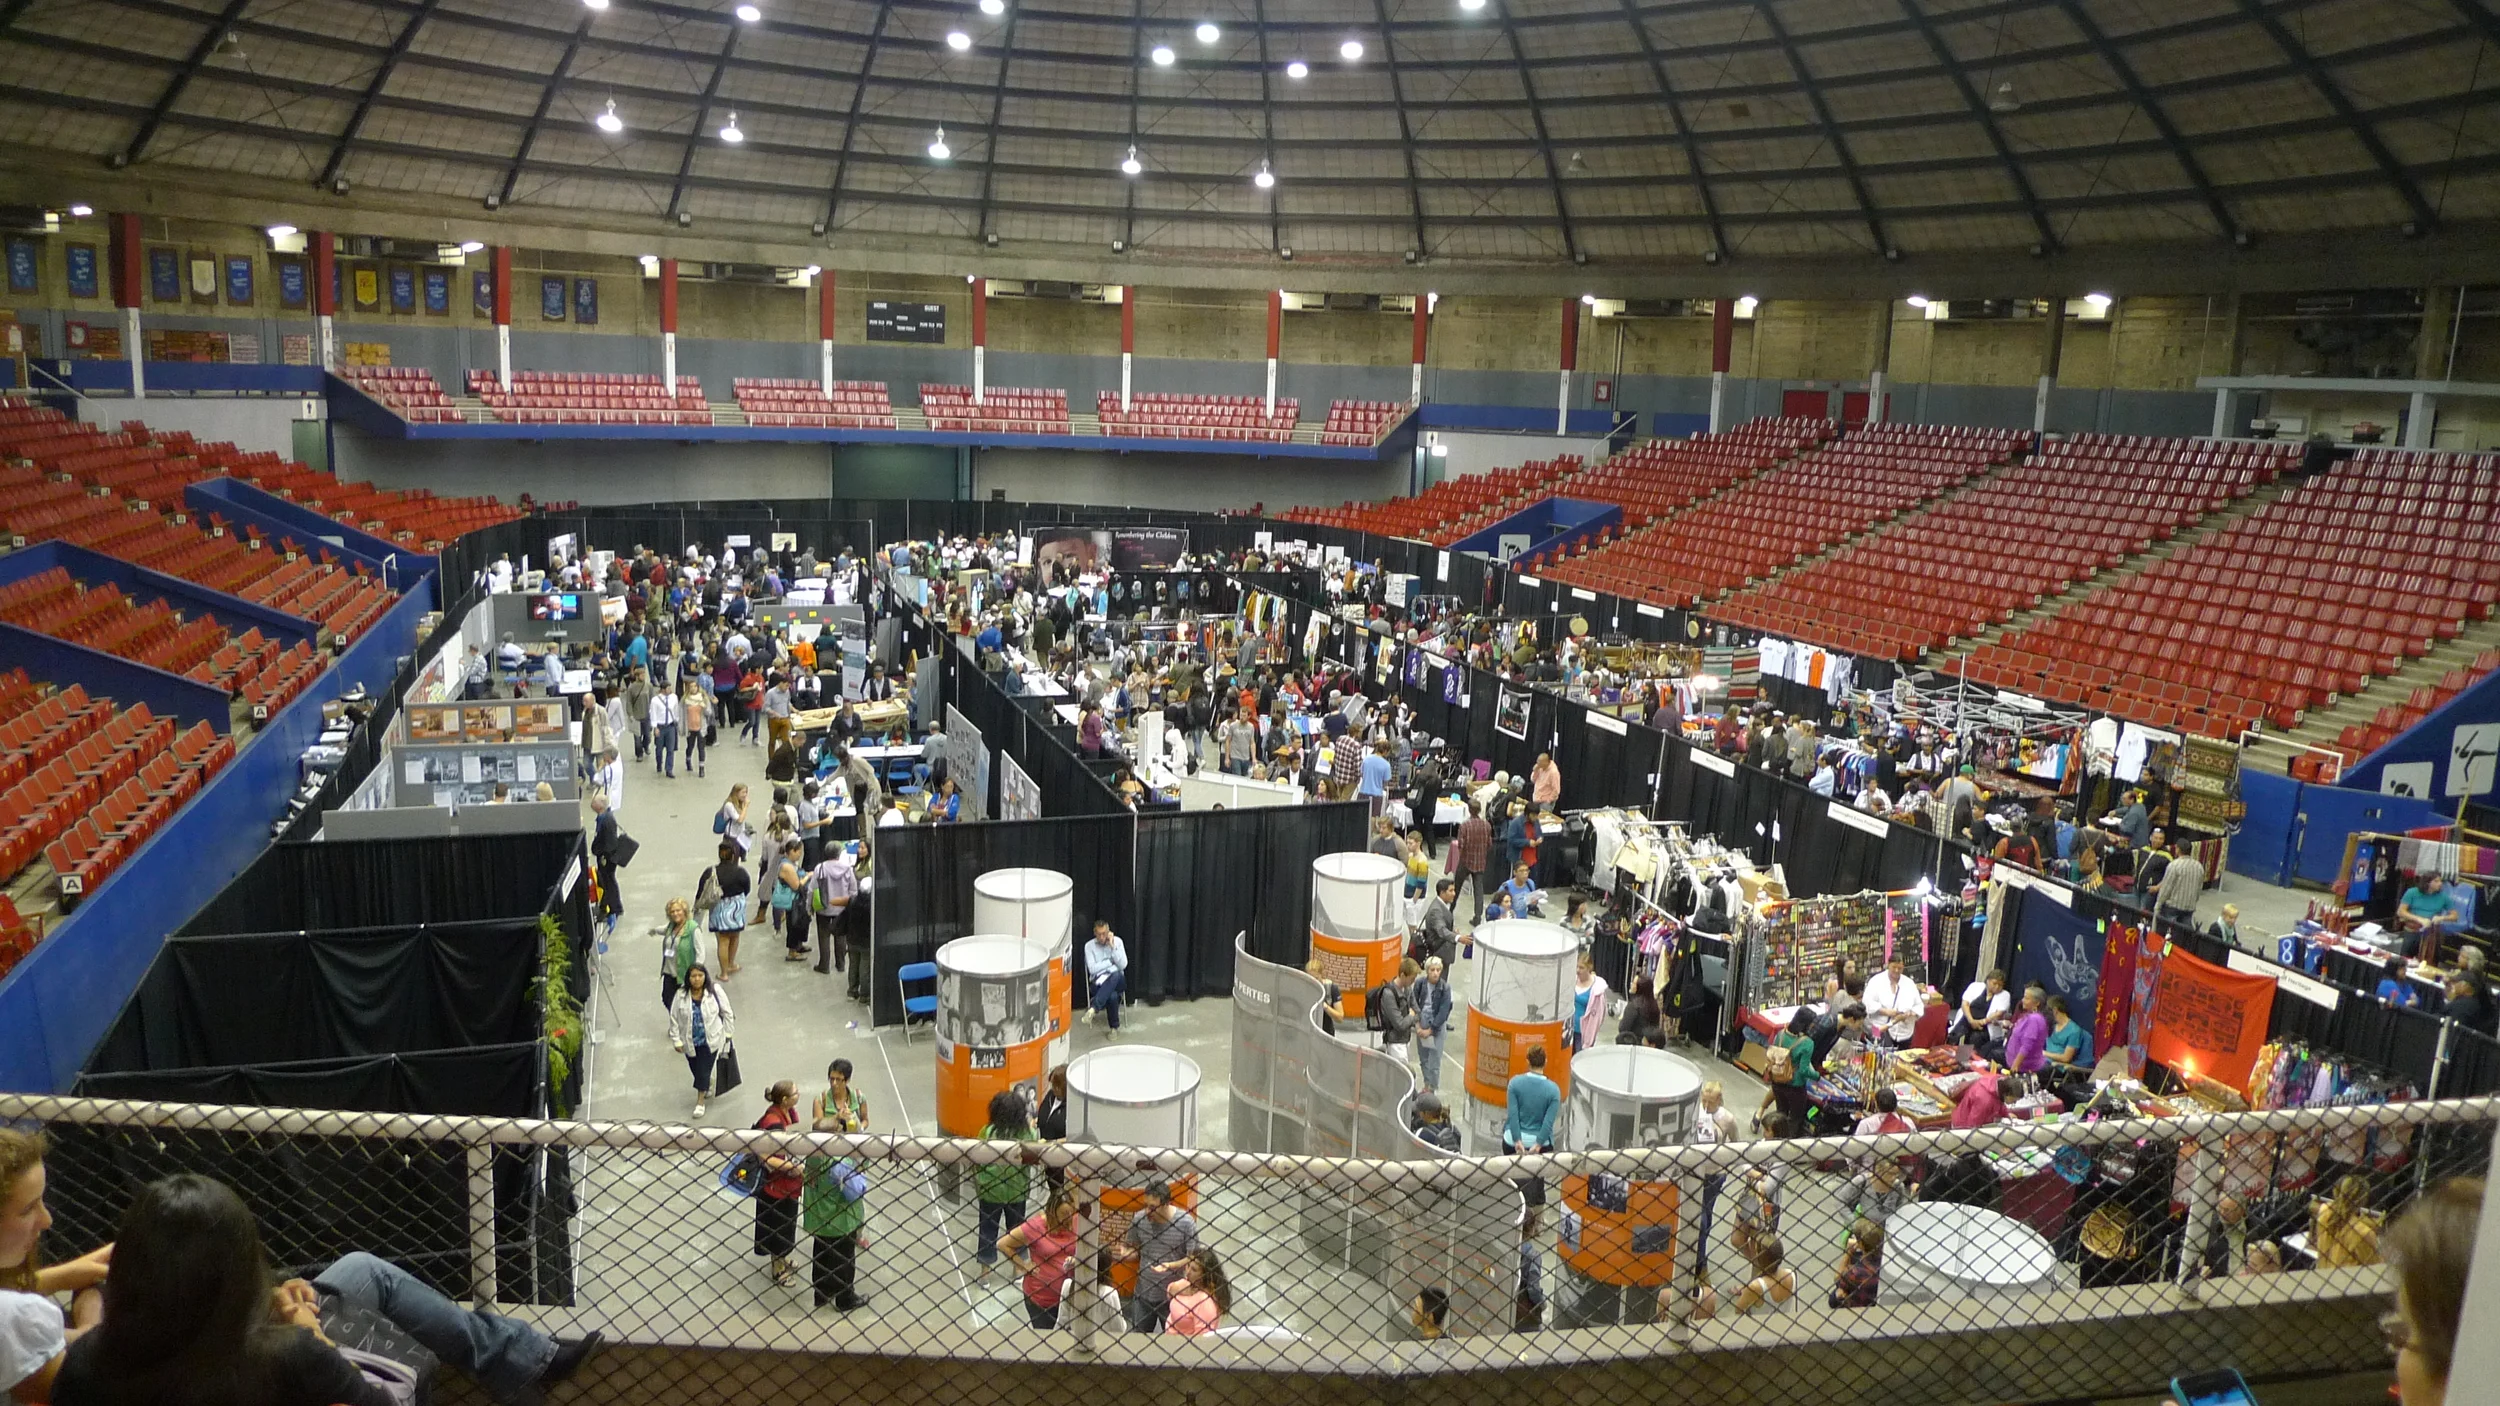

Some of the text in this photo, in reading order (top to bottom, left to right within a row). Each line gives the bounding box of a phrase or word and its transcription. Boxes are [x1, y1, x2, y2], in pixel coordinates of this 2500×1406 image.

[1115, 530, 1177, 541] Remembering the Children
[336, 635, 346, 645] A
[256, 707, 266, 716] A
[66, 879, 80, 889] A
[1238, 980, 1271, 1004] PERTES
